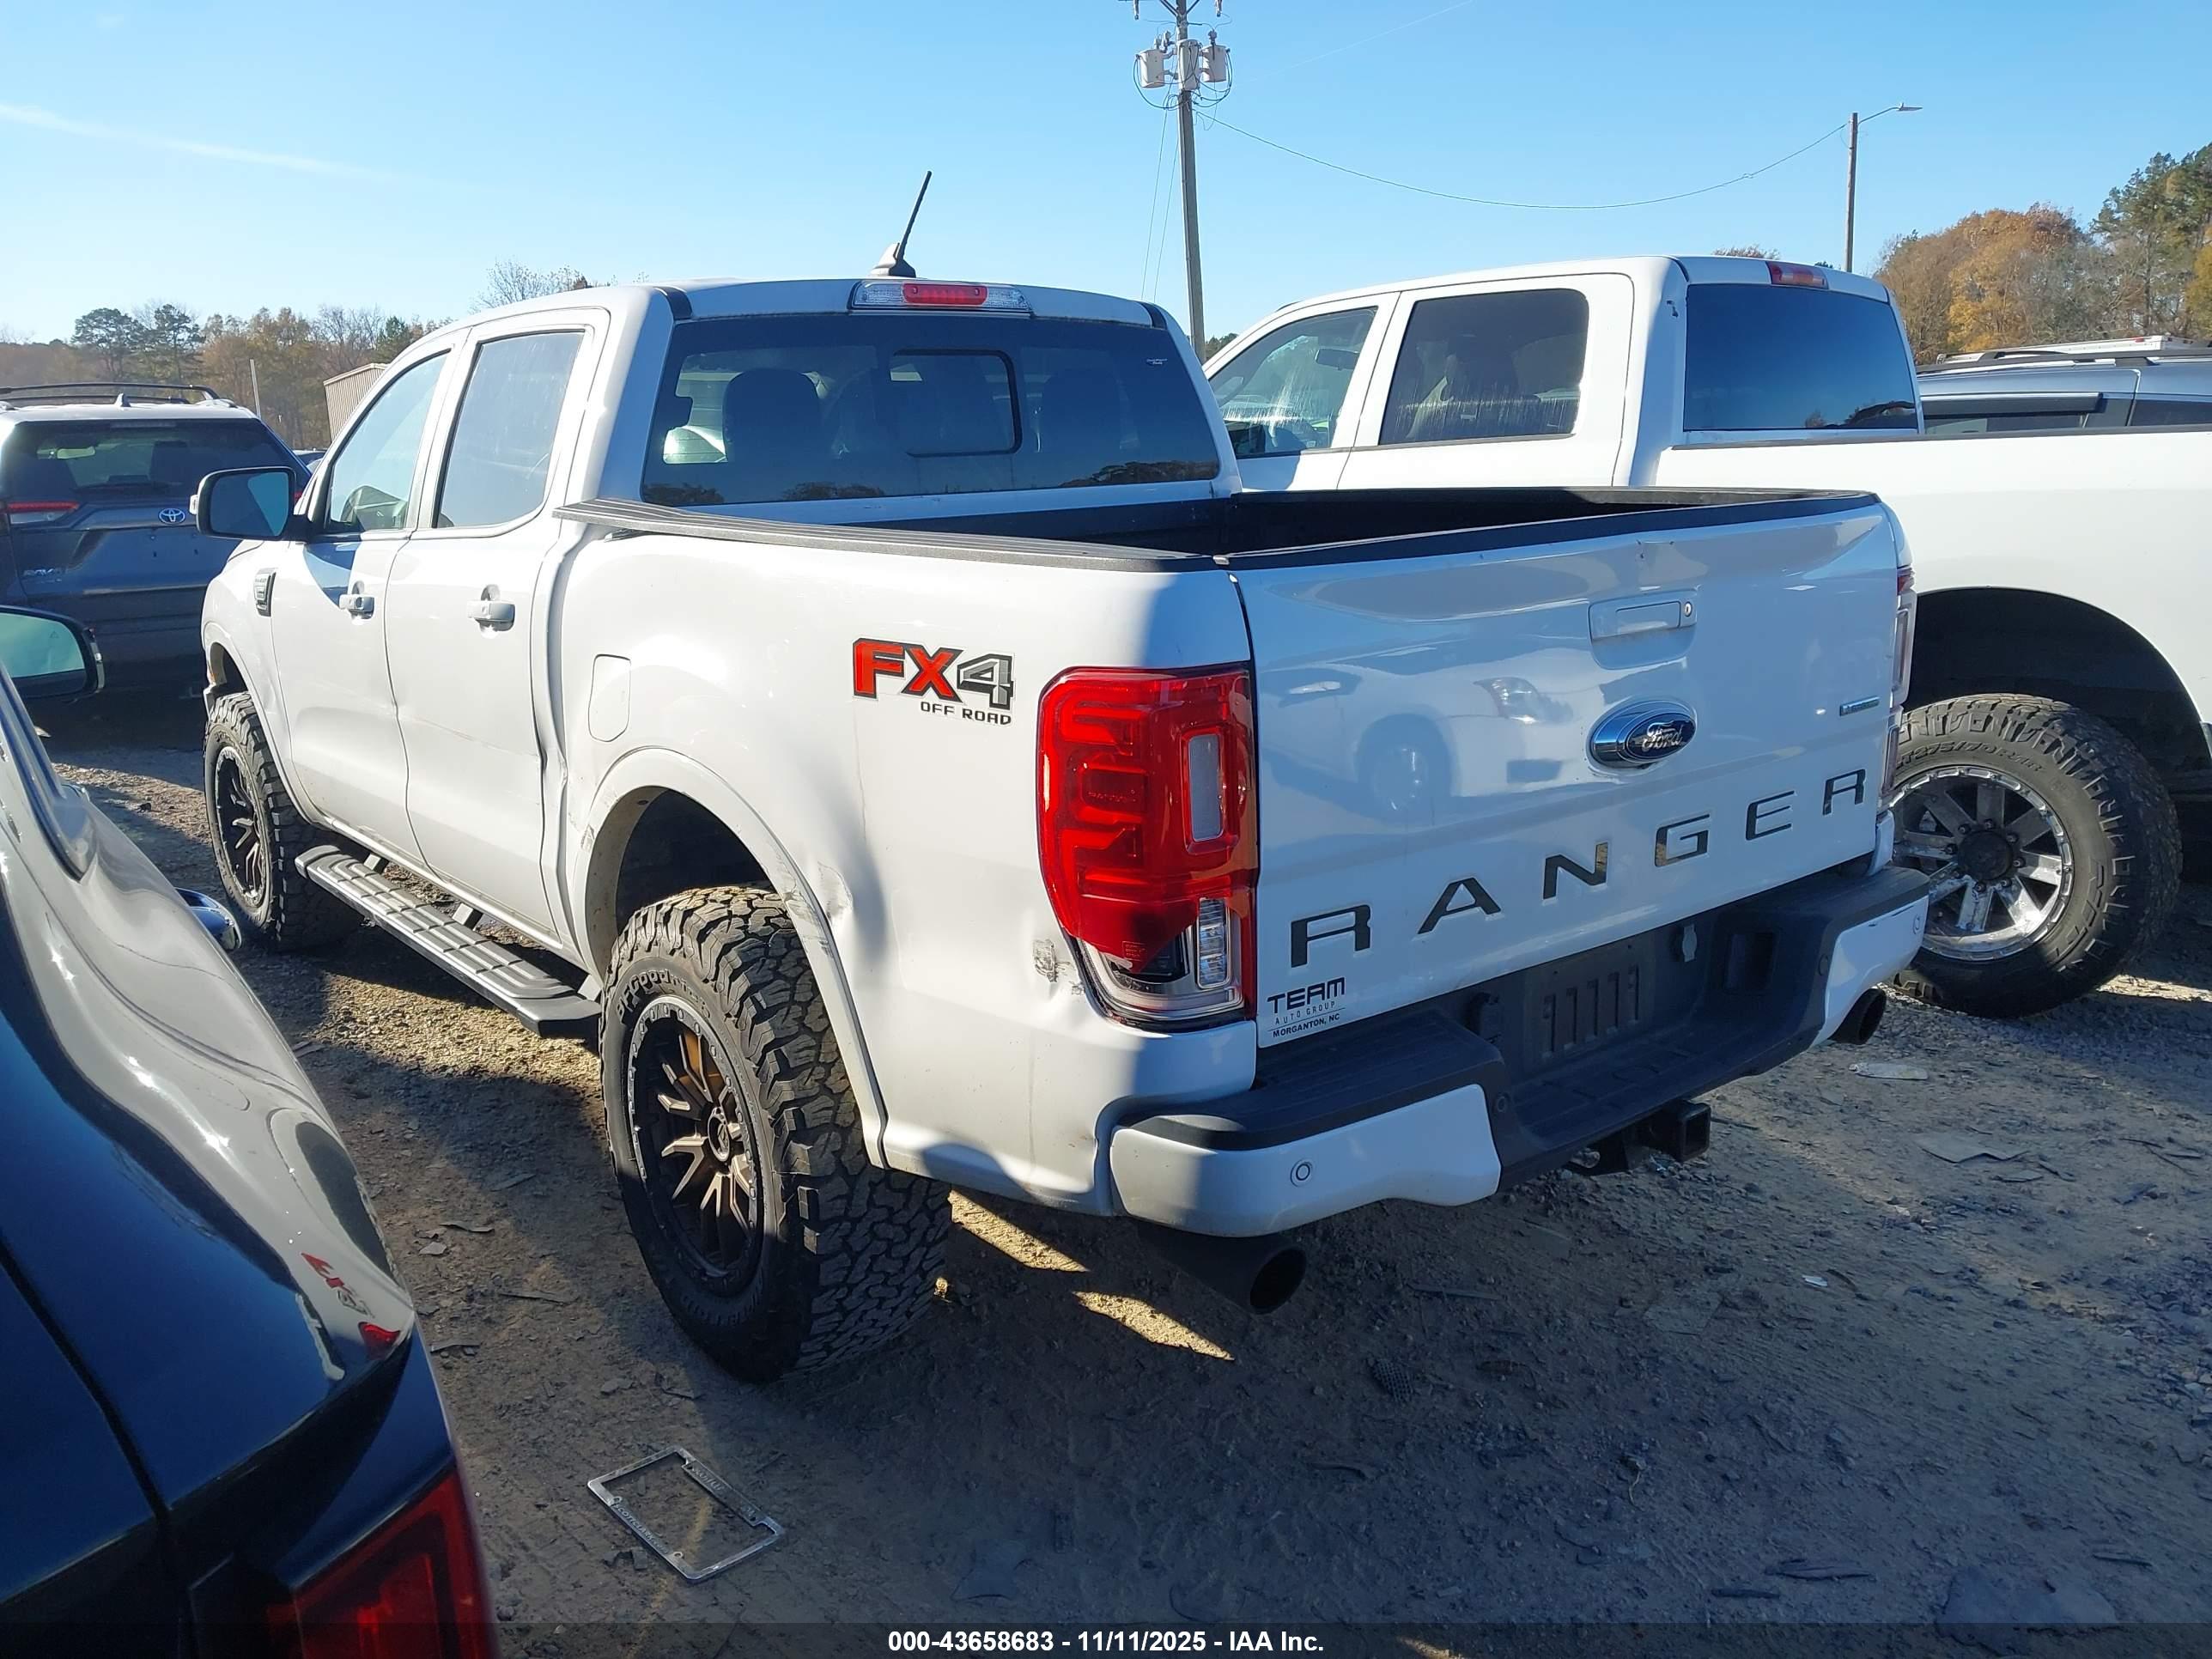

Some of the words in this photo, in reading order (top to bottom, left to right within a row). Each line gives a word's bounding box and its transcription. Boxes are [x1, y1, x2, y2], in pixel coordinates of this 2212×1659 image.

[853, 637, 1014, 711] FX4
[921, 701, 955, 715] OFF
[962, 708, 1012, 726] ROAD
[1642, 720, 1684, 752] Ford
[1290, 769, 1866, 969] RANGER
[1267, 976, 1345, 1014] TEAM
[1273, 1018, 1327, 1038] MORGANTON,
[1328, 1012, 1340, 1022] NC
[1274, 1010, 1301, 1025] AUTO
[1306, 1000, 1335, 1015] GROUP
